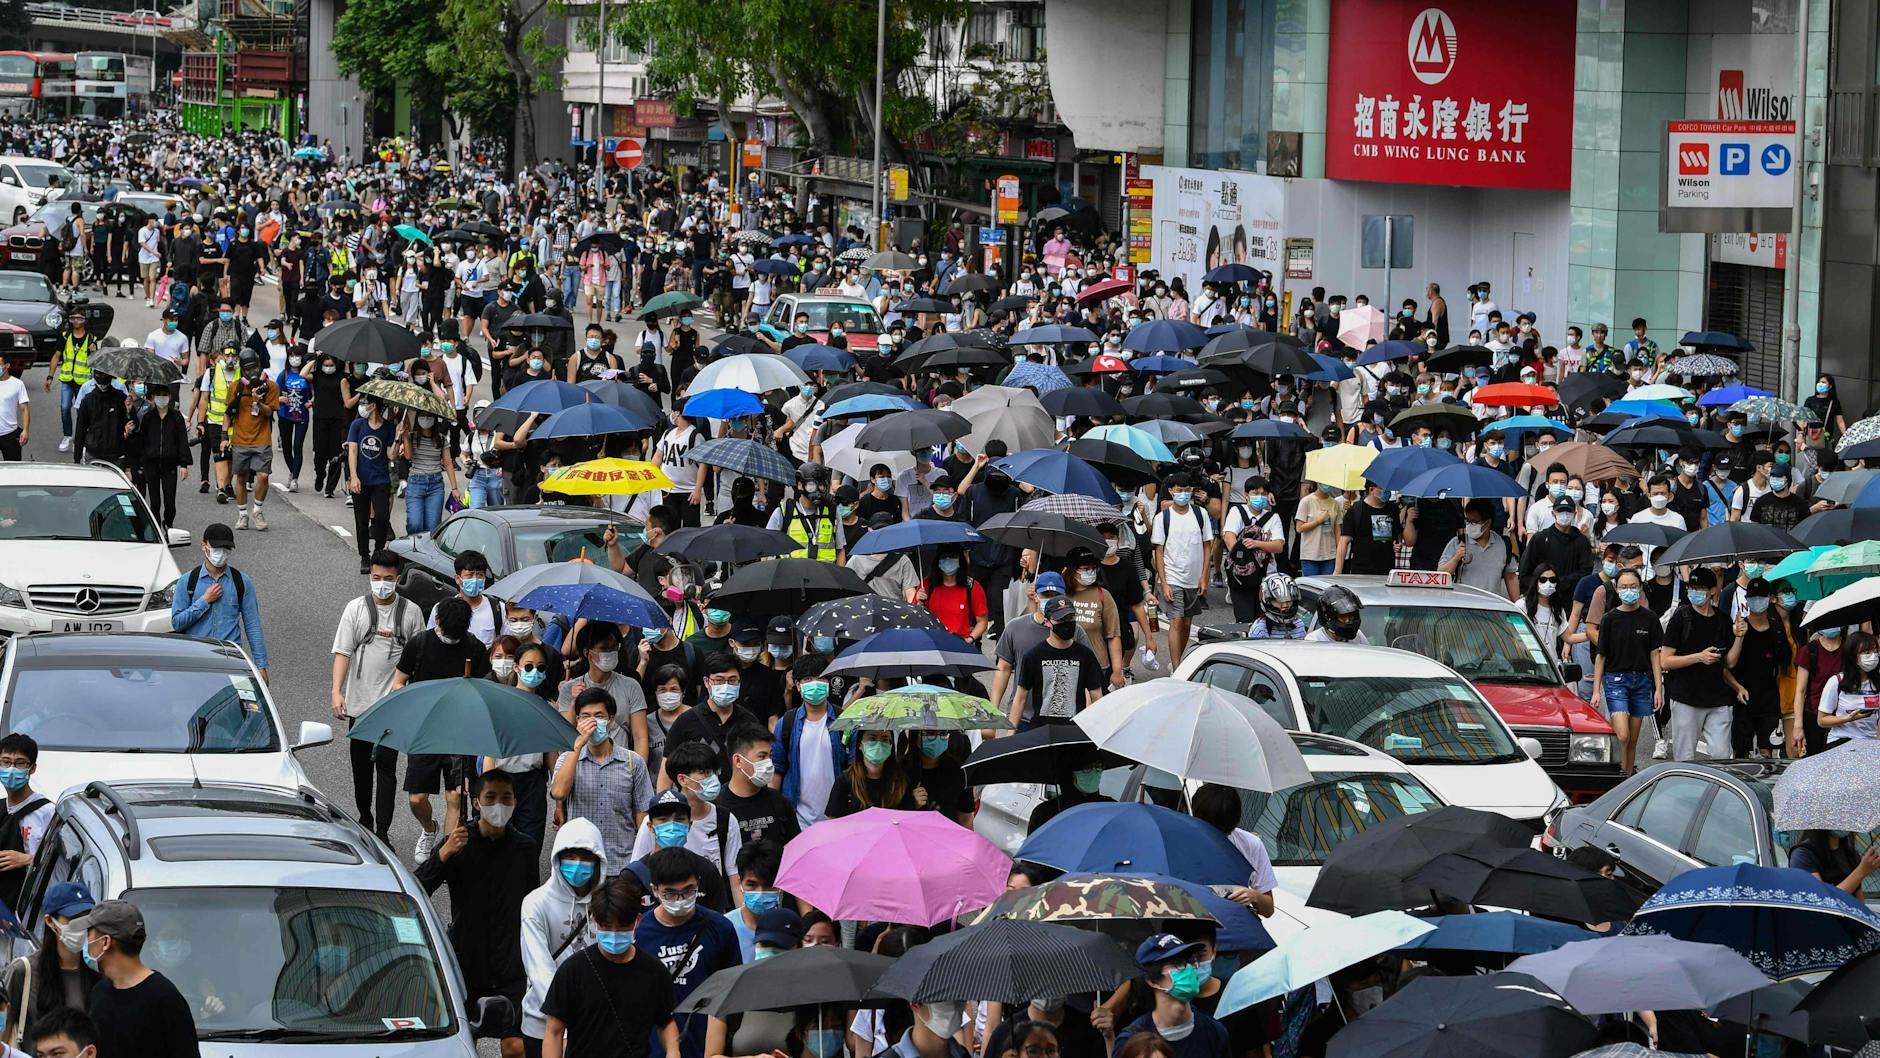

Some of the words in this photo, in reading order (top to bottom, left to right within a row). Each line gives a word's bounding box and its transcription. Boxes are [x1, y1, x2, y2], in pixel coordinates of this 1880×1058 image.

[1353, 93, 1529, 143] 招商永隆銀行
[1678, 123, 1698, 132] COFCO
[1700, 123, 1721, 132] TOWER
[1722, 123, 1732, 131] Car
[1734, 123, 1746, 131] Park
[1353, 143, 1378, 157] CMB
[1384, 145, 1419, 159] WING
[1426, 147, 1469, 161] LUNG
[1477, 149, 1526, 163] BANK
[1726, 148, 1745, 171] P
[1678, 179, 1710, 187] Wilson
[1678, 190, 1709, 200] Parking
[1397, 572, 1447, 585] TAXI
[1073, 600, 1089, 608] love
[64, 622, 82, 631] AW
[657, 943, 688, 958] Just
